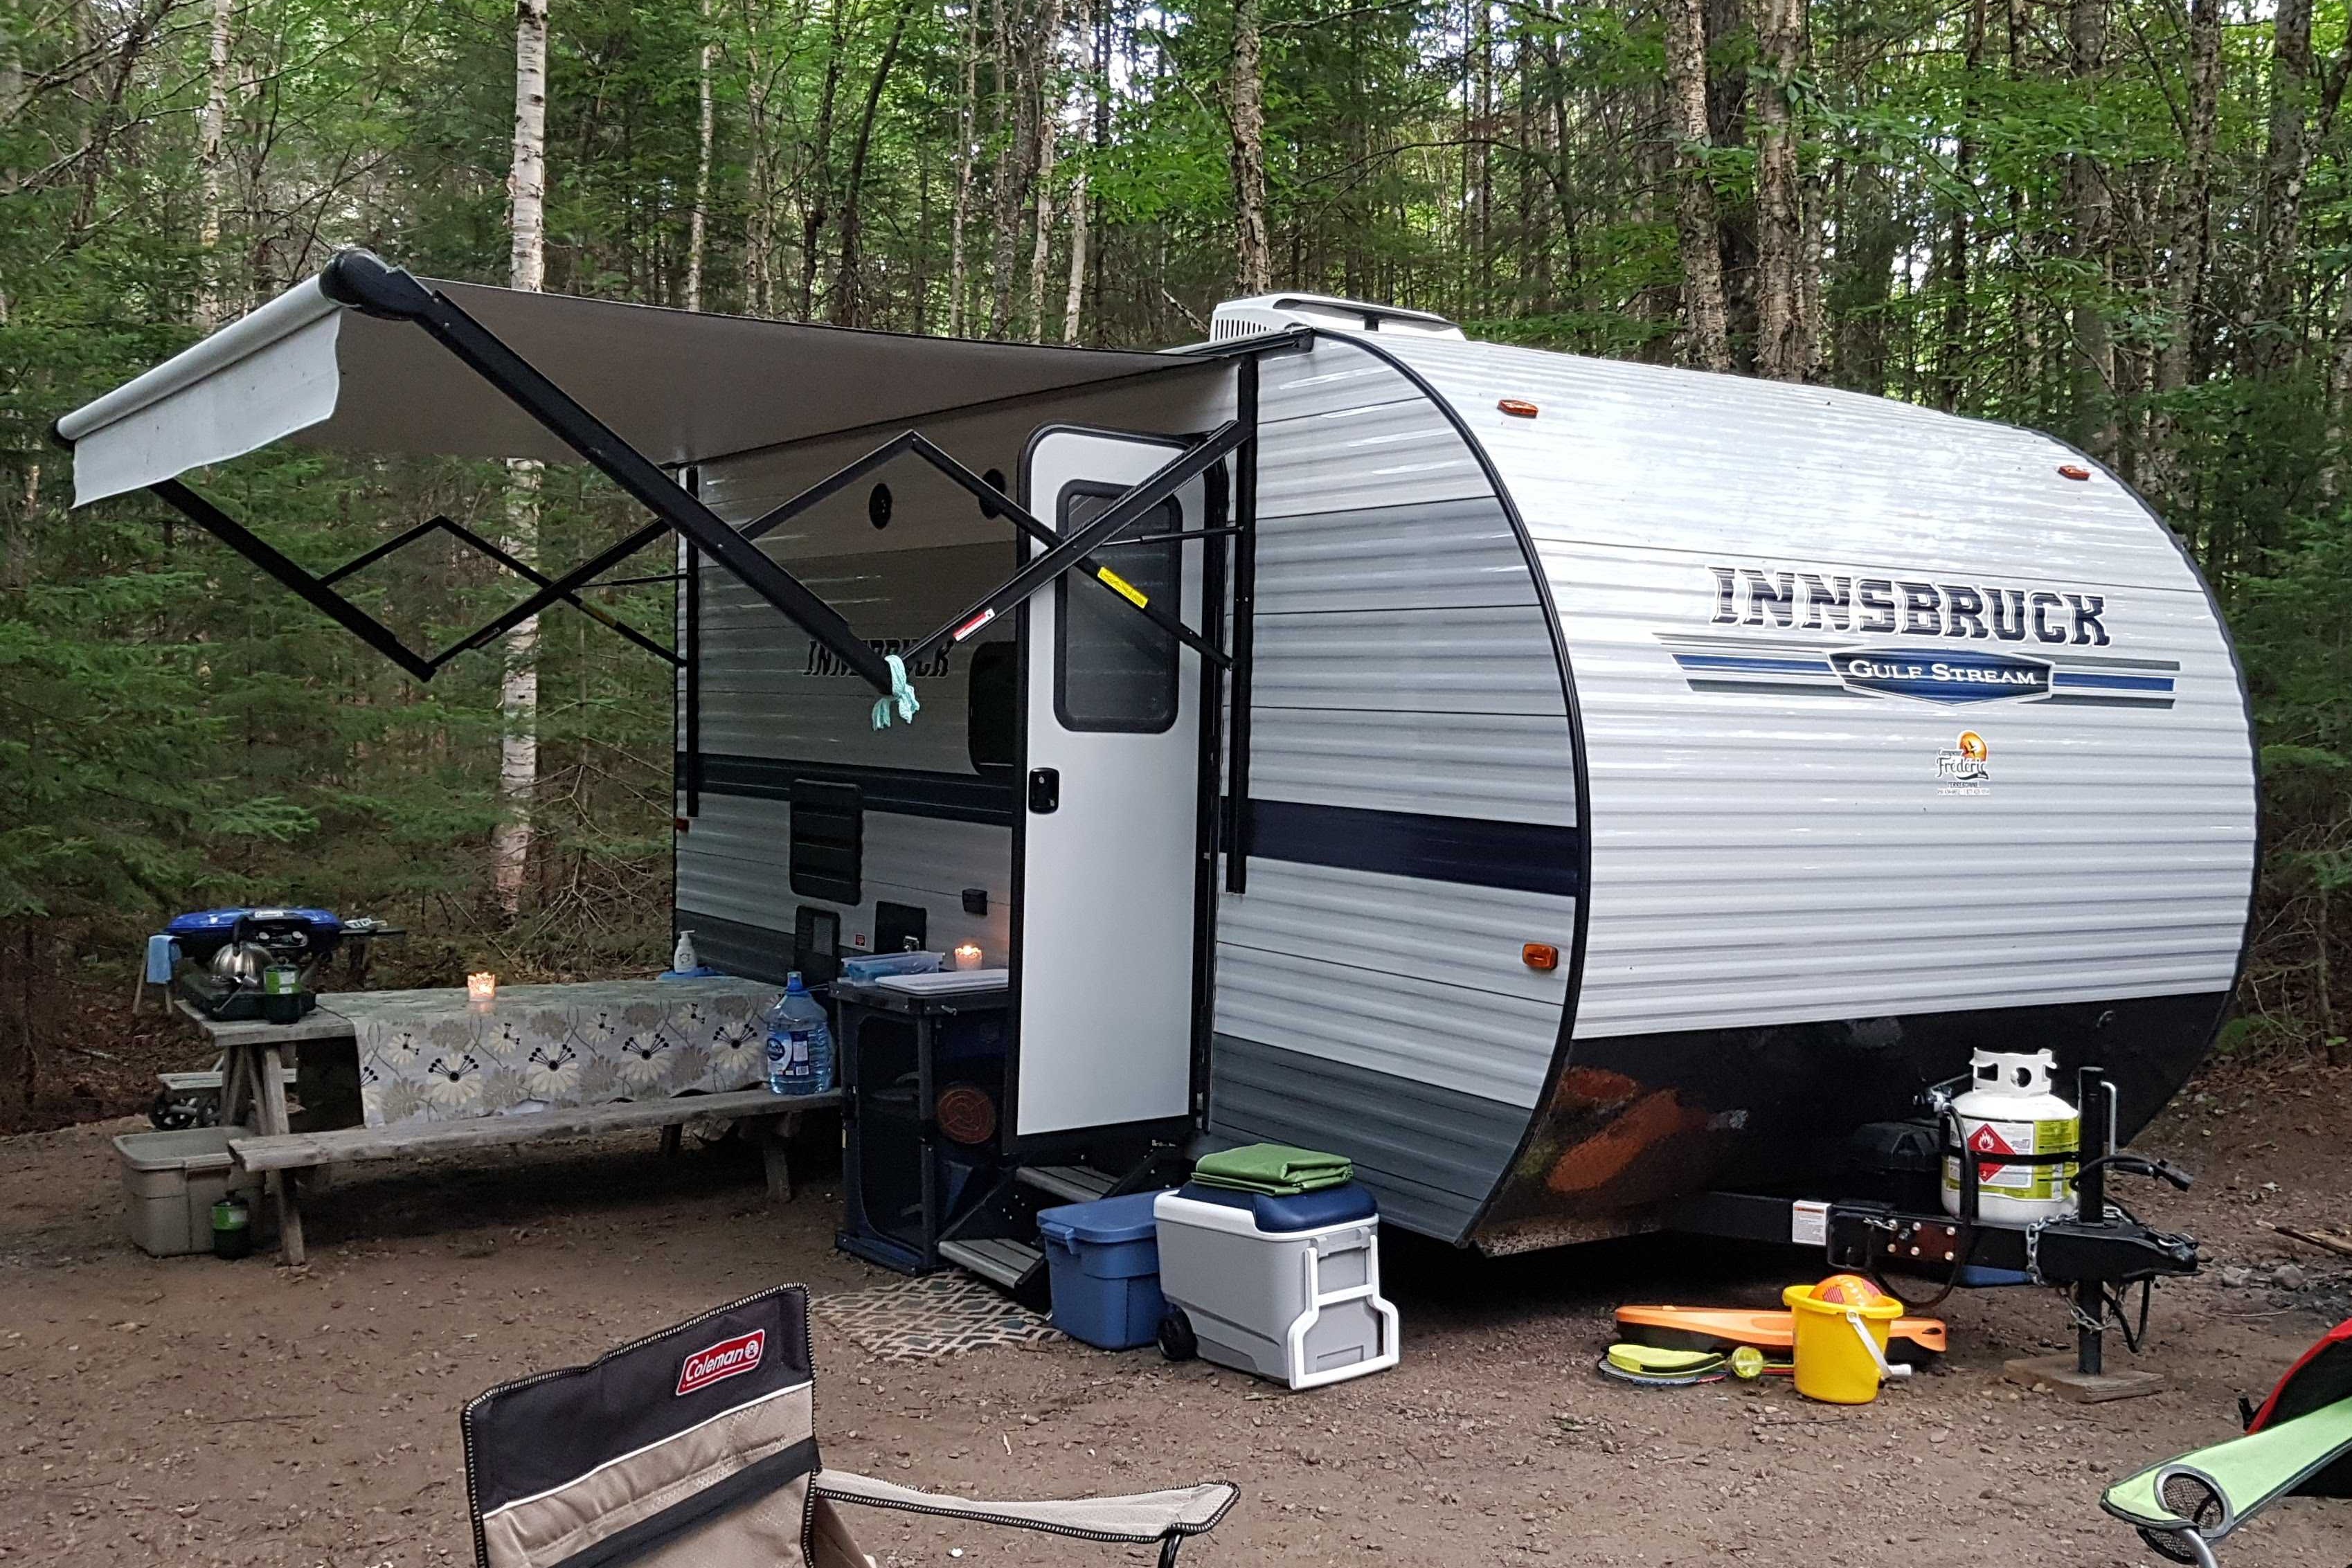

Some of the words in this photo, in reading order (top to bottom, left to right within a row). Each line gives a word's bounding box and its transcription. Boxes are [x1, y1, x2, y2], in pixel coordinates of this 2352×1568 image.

[1708, 566, 2111, 647] INNSBRUCK
[1848, 659, 1923, 679] GULF
[1930, 663, 2037, 685] STREAM
[685, 1348, 744, 1382] Coleman
